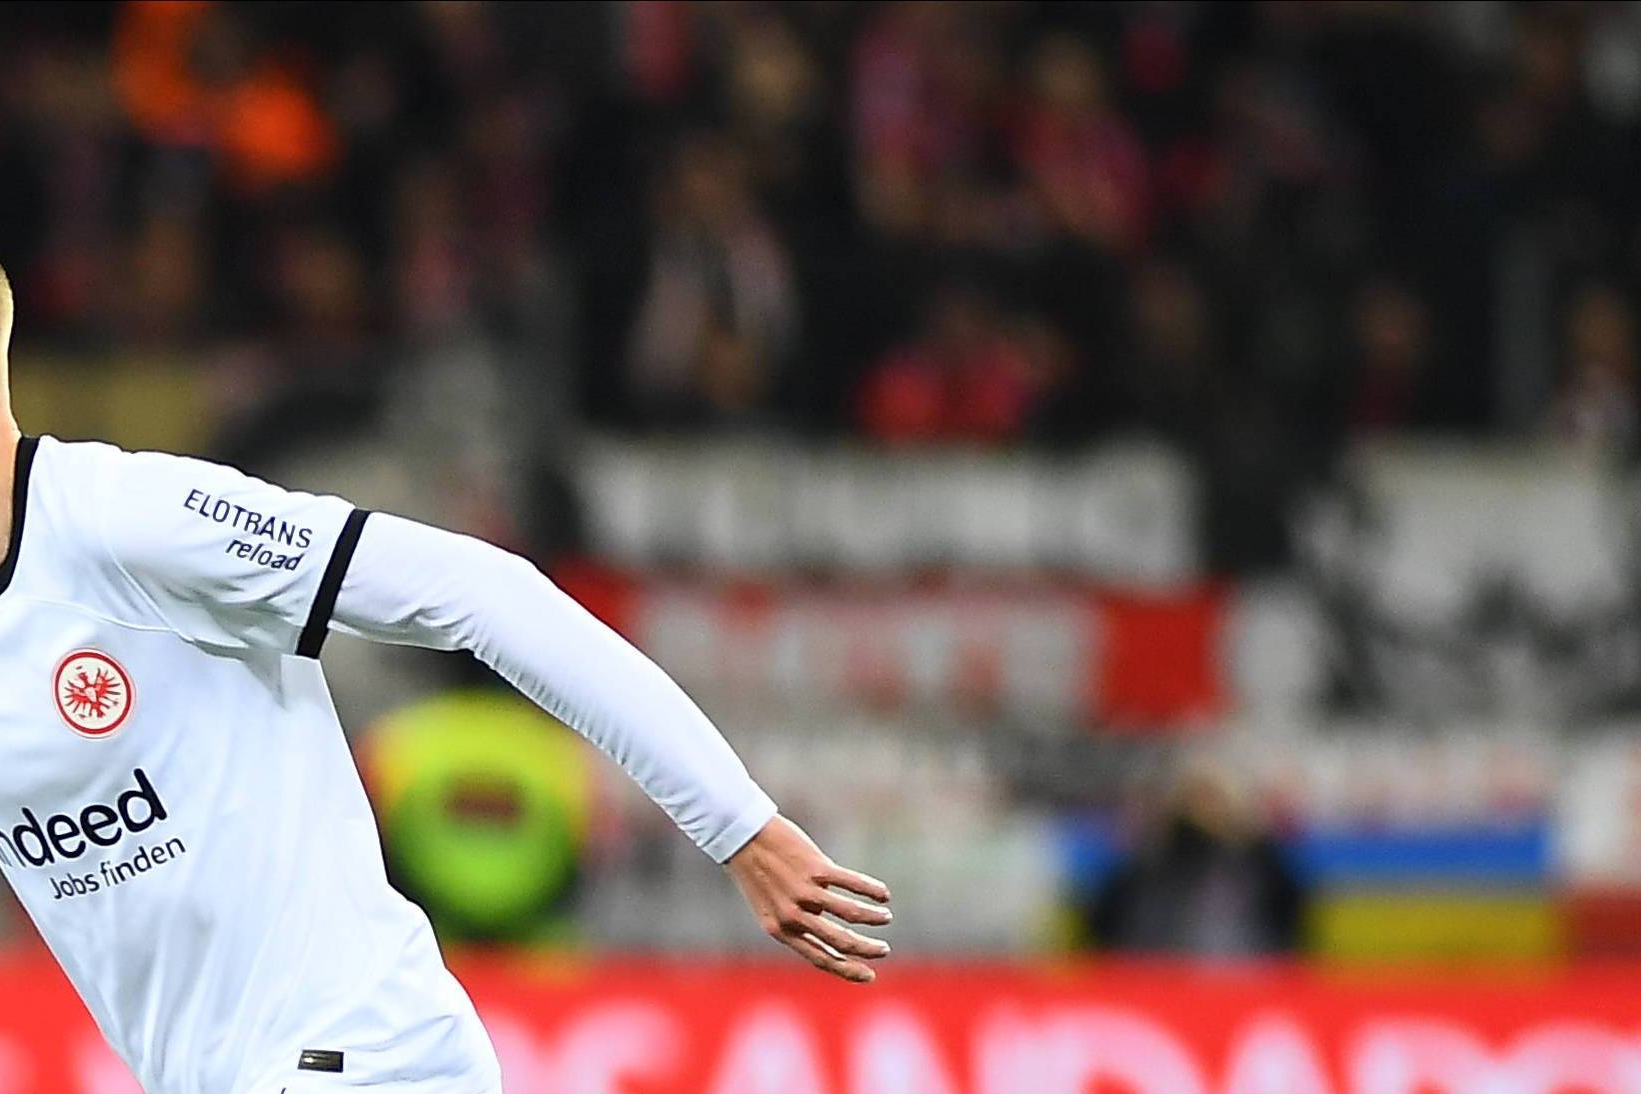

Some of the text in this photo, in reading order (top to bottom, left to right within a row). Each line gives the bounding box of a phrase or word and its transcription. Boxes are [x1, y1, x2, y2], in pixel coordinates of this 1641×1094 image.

[183, 488, 313, 549] ELOTRANS
[225, 539, 305, 571] reload
[50, 837, 186, 900] Jobs finden
